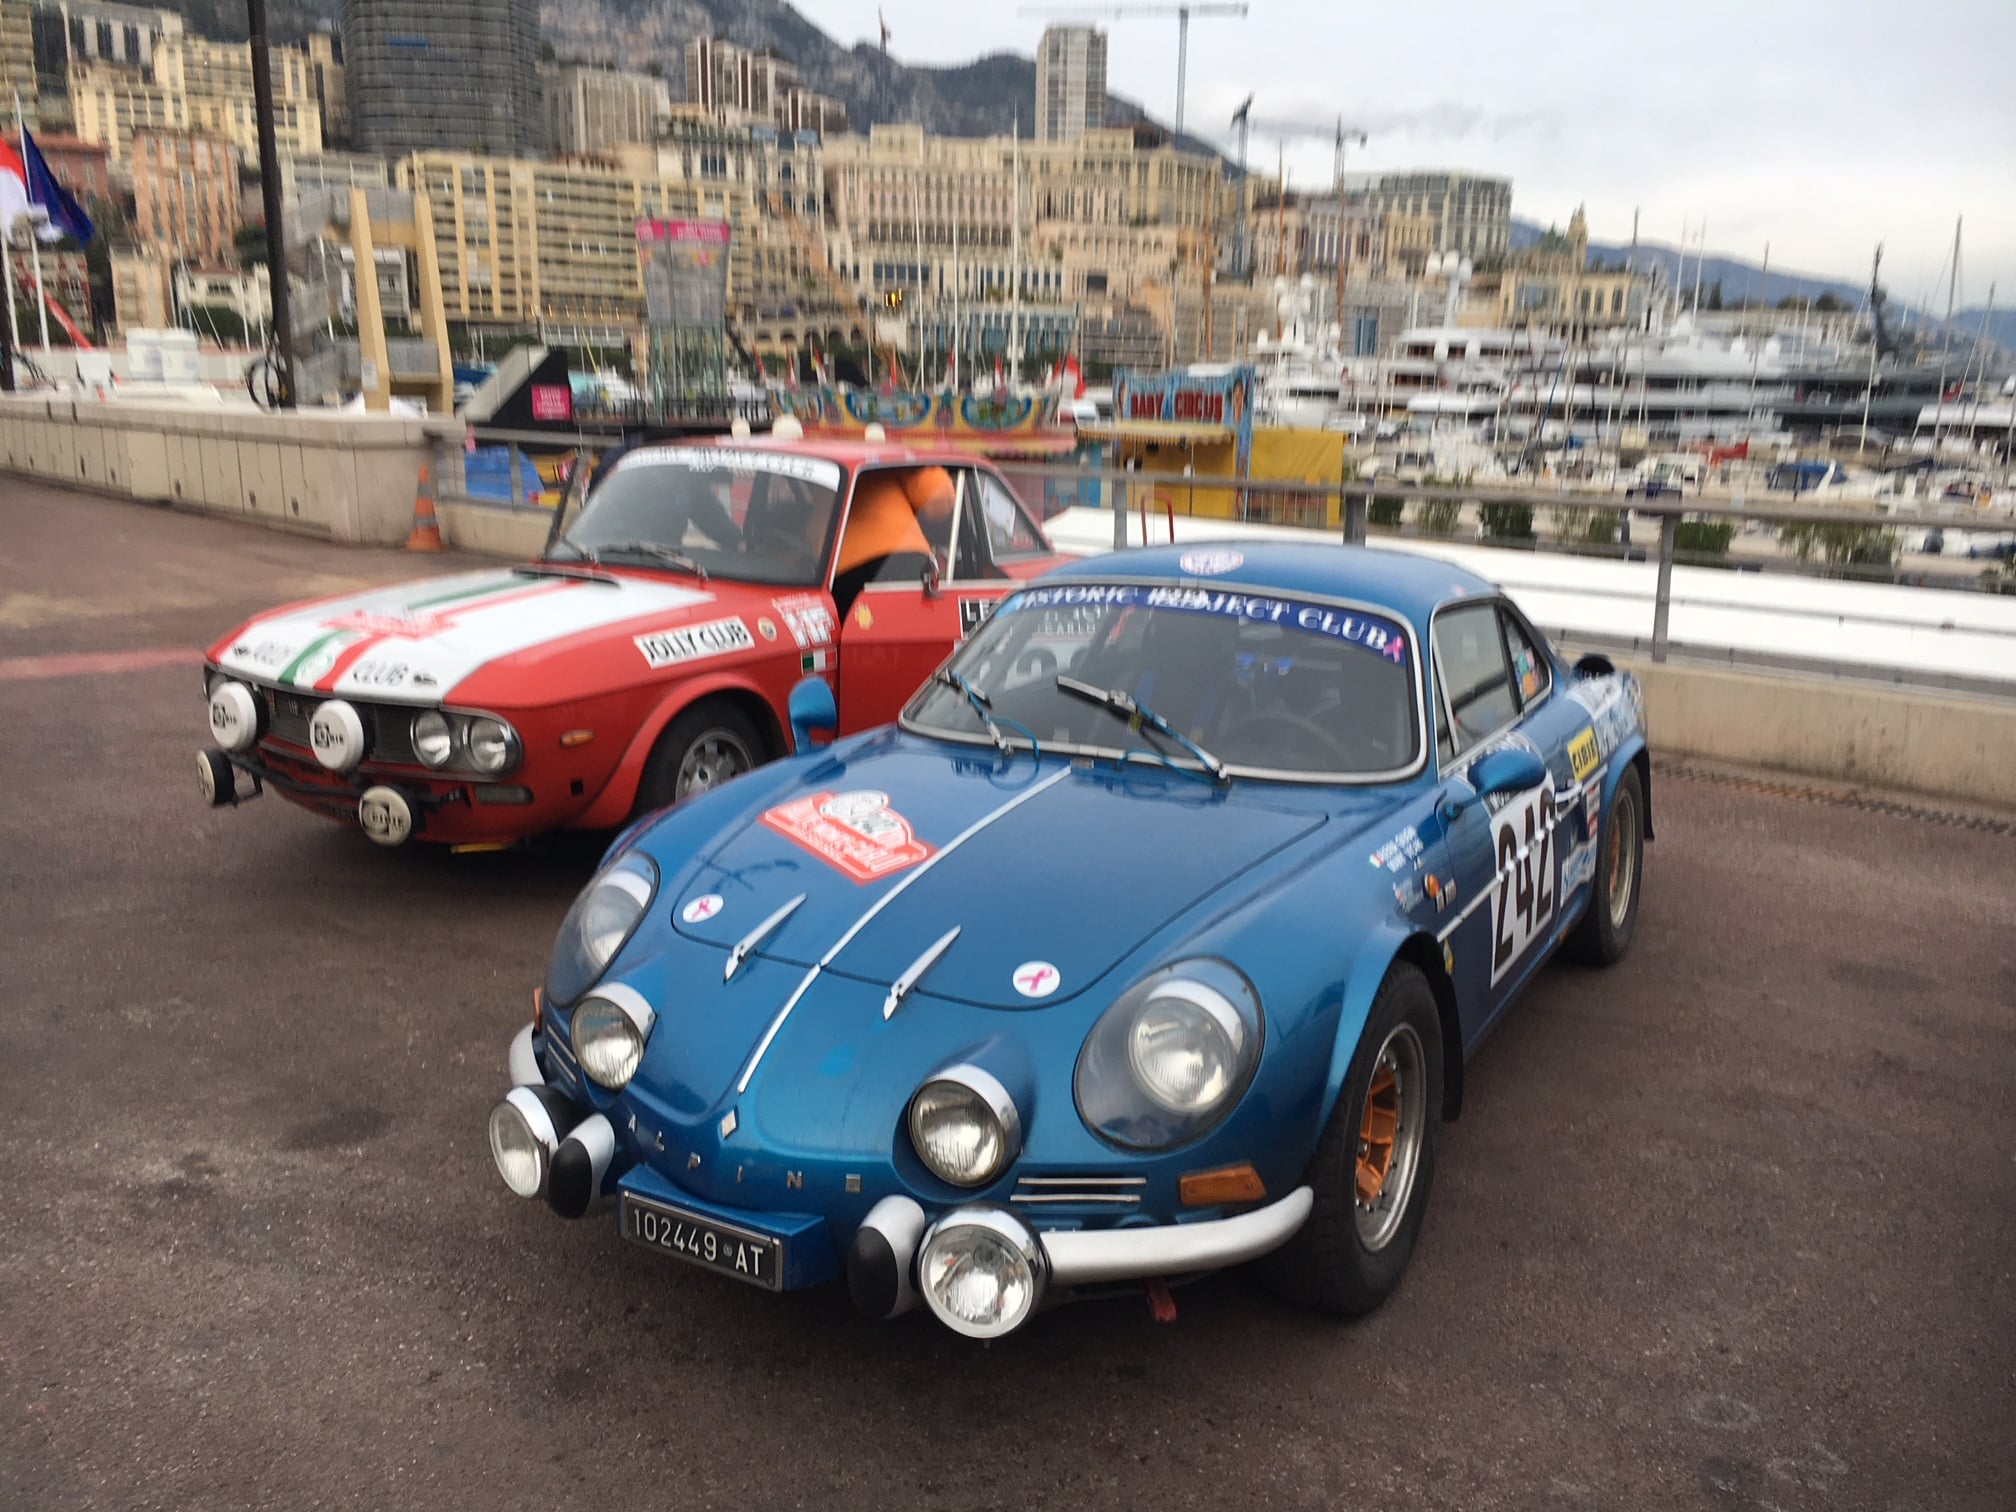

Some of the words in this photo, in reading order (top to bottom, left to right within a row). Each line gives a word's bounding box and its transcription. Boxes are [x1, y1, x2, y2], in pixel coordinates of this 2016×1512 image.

[1131, 391, 1164, 420] BABY
[1174, 387, 1224, 424] CIRCUS
[641, 630, 698, 663] JOLLY
[699, 620, 749, 652] CLUB
[1297, 607, 1389, 651] CLUB
[1493, 787, 1556, 973] 242
[627, 1113, 863, 1194] ALPINE
[632, 1207, 718, 1262] 102449
[734, 1242, 765, 1278] AT
